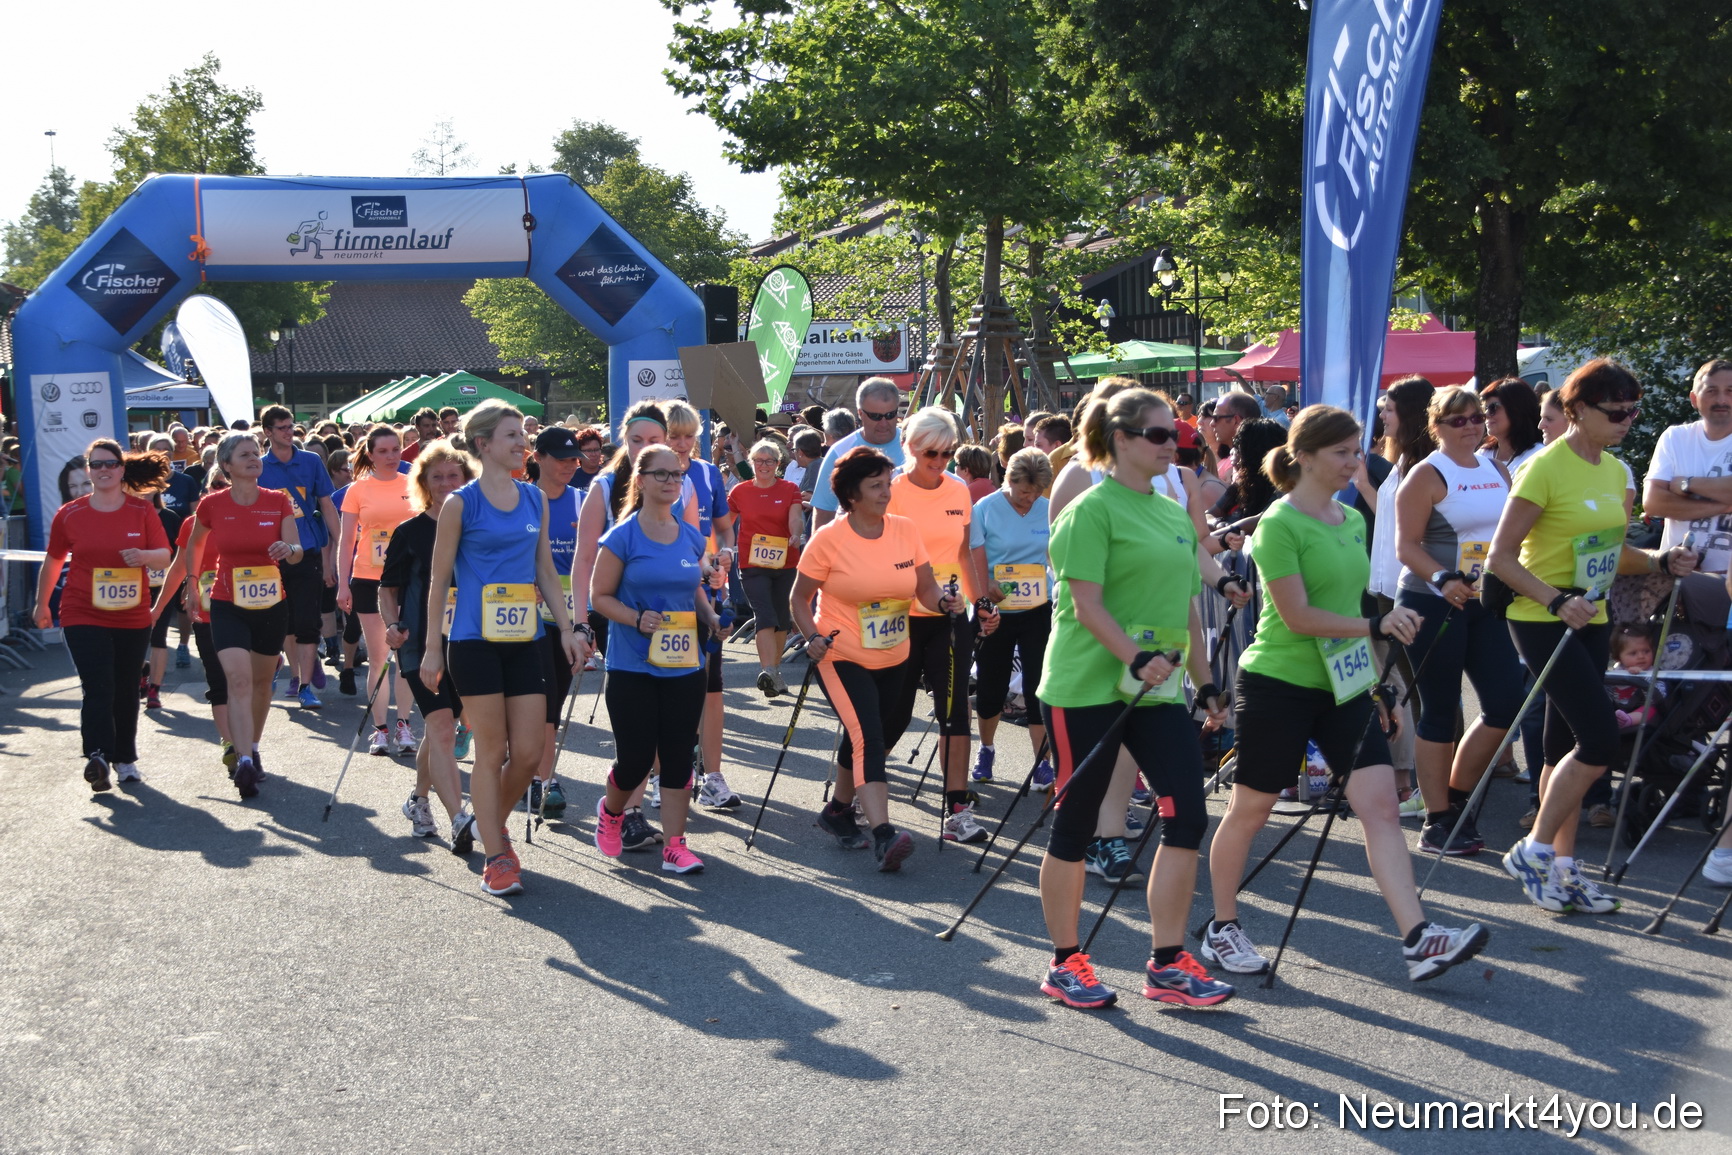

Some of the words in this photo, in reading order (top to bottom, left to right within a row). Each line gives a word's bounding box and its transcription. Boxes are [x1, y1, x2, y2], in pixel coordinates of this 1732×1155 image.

[364, 208, 404, 217] Fischer
[334, 228, 454, 250] firmenlauf
[333, 251, 384, 259] neumarkt
[577, 267, 595, 277] und
[596, 265, 614, 275] das
[97, 274, 165, 288] Fischer
[600, 275, 624, 287] fährt
[103, 287, 159, 295] AUTOMOBILE
[813, 351, 831, 359] grüßt
[126, 394, 174, 402] omobile.de
[754, 547, 784, 561] 1057
[1586, 553, 1615, 578] 646
[98, 585, 137, 599] 1055
[239, 583, 278, 598] 1054
[495, 607, 528, 625] 567
[867, 615, 905, 639] 1446
[660, 634, 690, 652] 566
[1333, 645, 1369, 682] 1545
